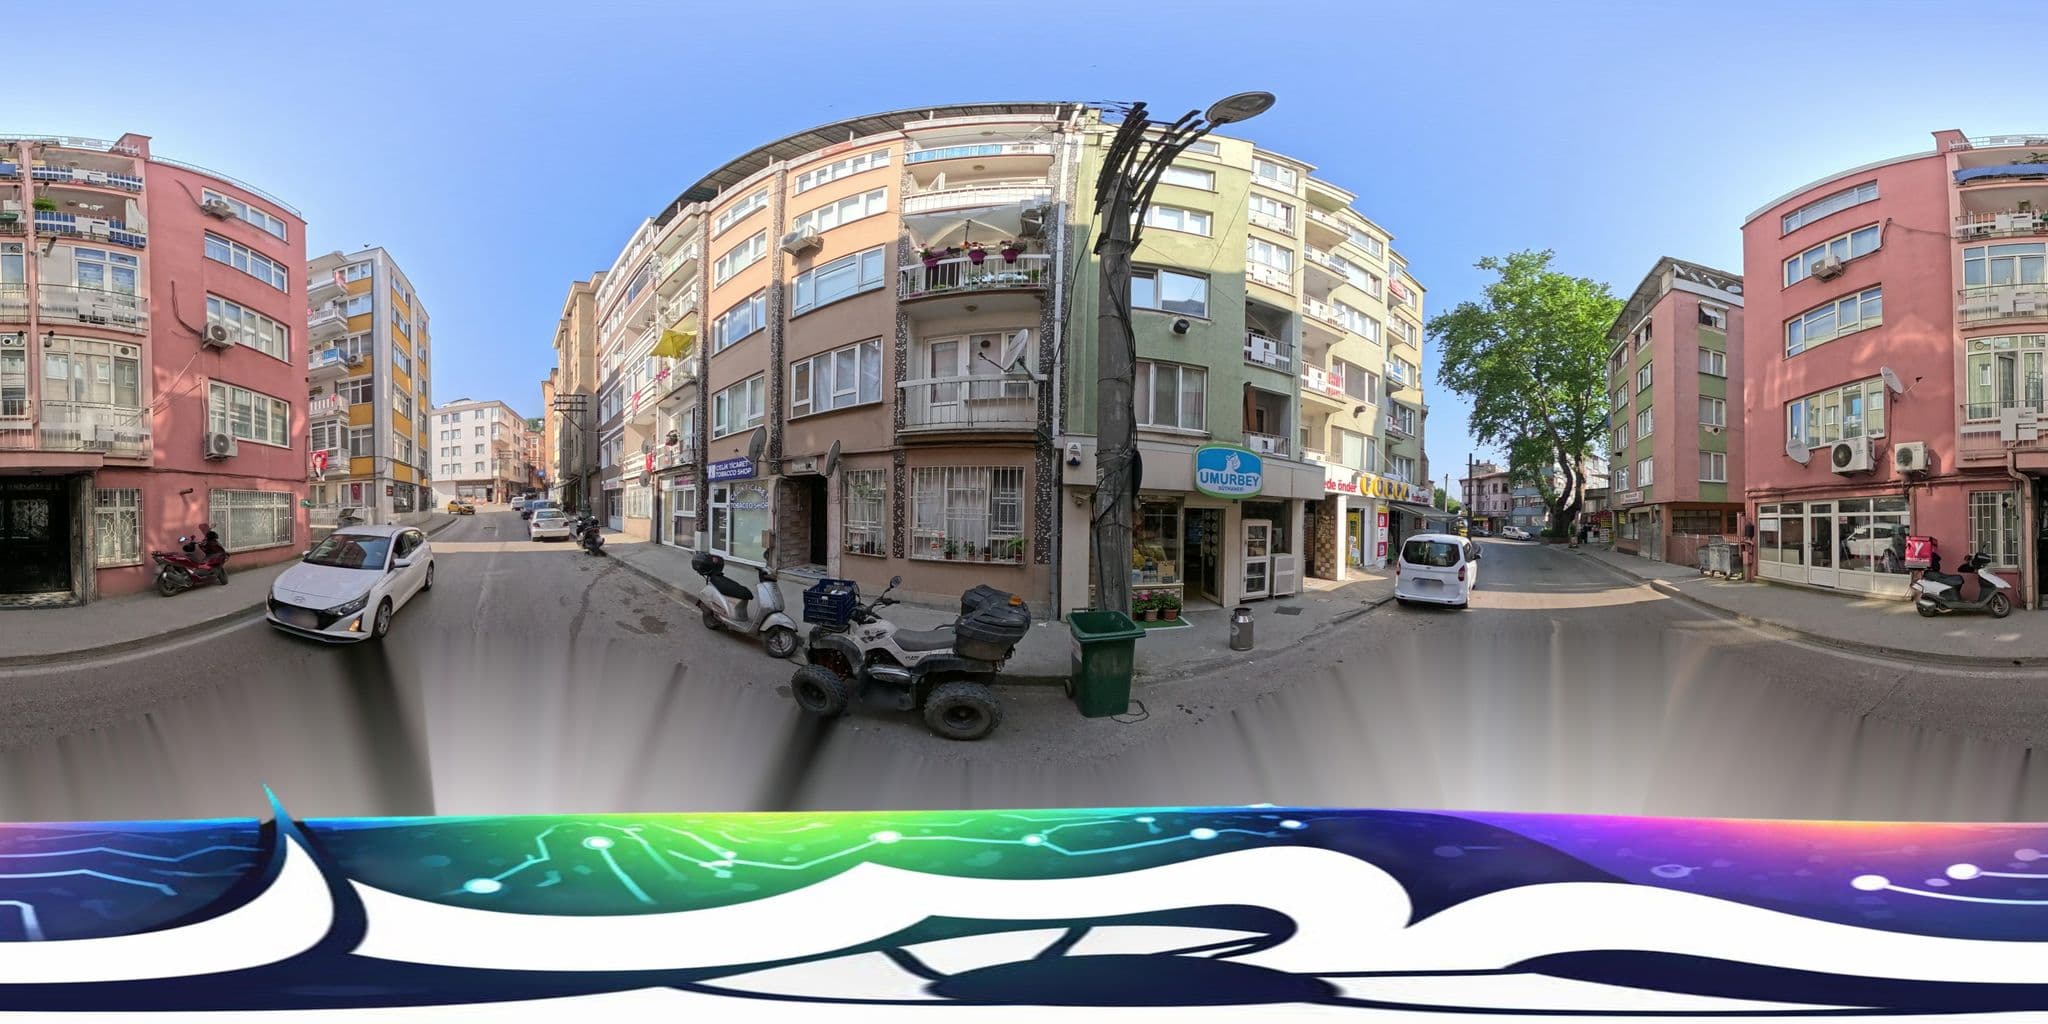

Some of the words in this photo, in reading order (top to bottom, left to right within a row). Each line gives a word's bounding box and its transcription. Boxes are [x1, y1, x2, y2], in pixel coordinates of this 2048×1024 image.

[715, 469, 737, 478] TOBACCO
[737, 467, 752, 475] SHOP
[1200, 471, 1260, 487] UMURBEY
[1360, 473, 1410, 500] FÜRPA
